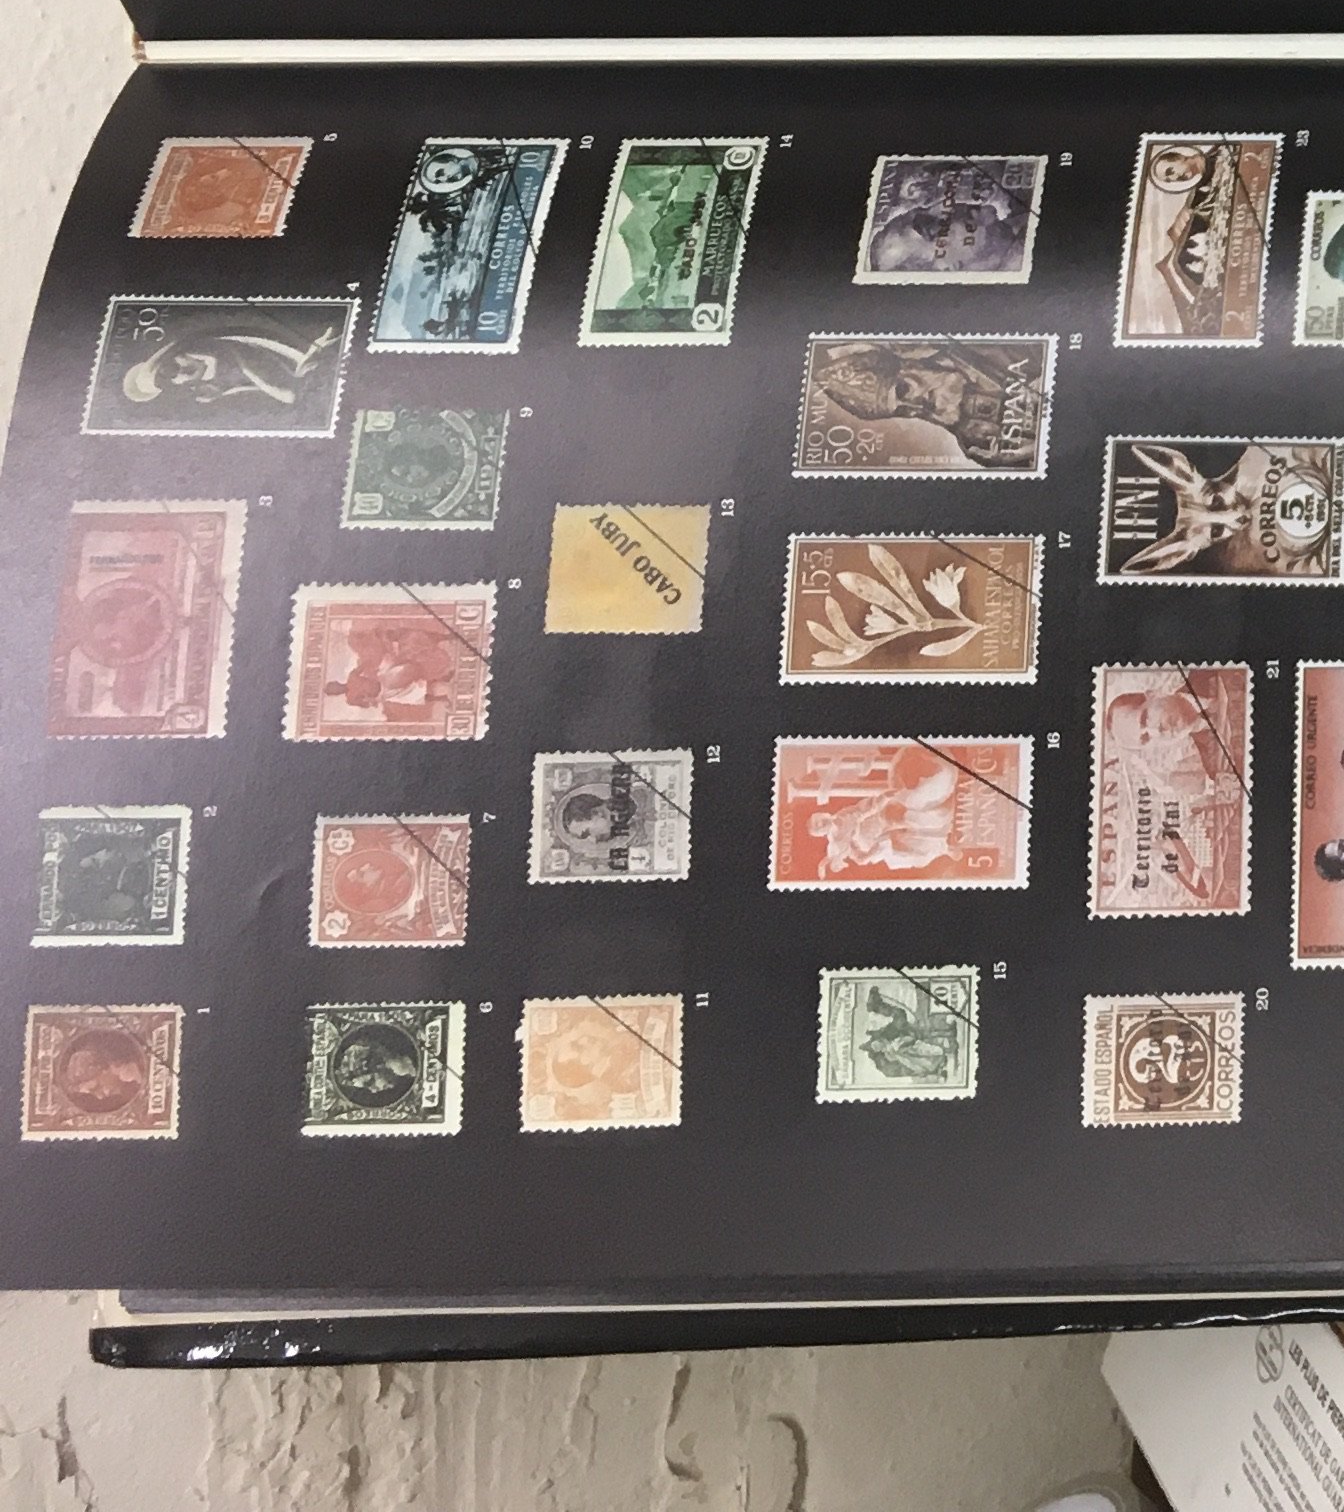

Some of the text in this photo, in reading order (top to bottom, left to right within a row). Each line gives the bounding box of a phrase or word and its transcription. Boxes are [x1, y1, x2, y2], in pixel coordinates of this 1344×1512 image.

[579, 134, 595, 151] 10
[779, 133, 794, 149] 14
[1295, 129, 1310, 147] 23
[487, 204, 516, 269] CORREOS
[702, 193, 729, 277] MARRUECOS
[1230, 203, 1248, 267] CORREOS
[476, 311, 499, 333] 10
[1068, 333, 1083, 351] 18
[805, 431, 824, 465] RIO
[827, 425, 855, 465] 50
[1113, 475, 1161, 540] IFNI
[1261, 455, 1287, 563] CORREOS
[1281, 498, 1305, 521] 5
[590, 510, 683, 606] CABO JUBY
[706, 745, 721, 764] 12
[1046, 732, 1061, 749] 16
[1305, 694, 1318, 810] CORREO URGENTE
[779, 811, 795, 875] CORREOS
[968, 854, 993, 869] 5
[1131, 786, 1153, 891] Territorio
[1160, 800, 1182, 875] de Ifni
[1255, 987, 1270, 1012] 20
[1092, 1004, 1114, 1124] ESTADO ESPAÑOL
[1214, 1011, 1236, 1112] CORREOS
